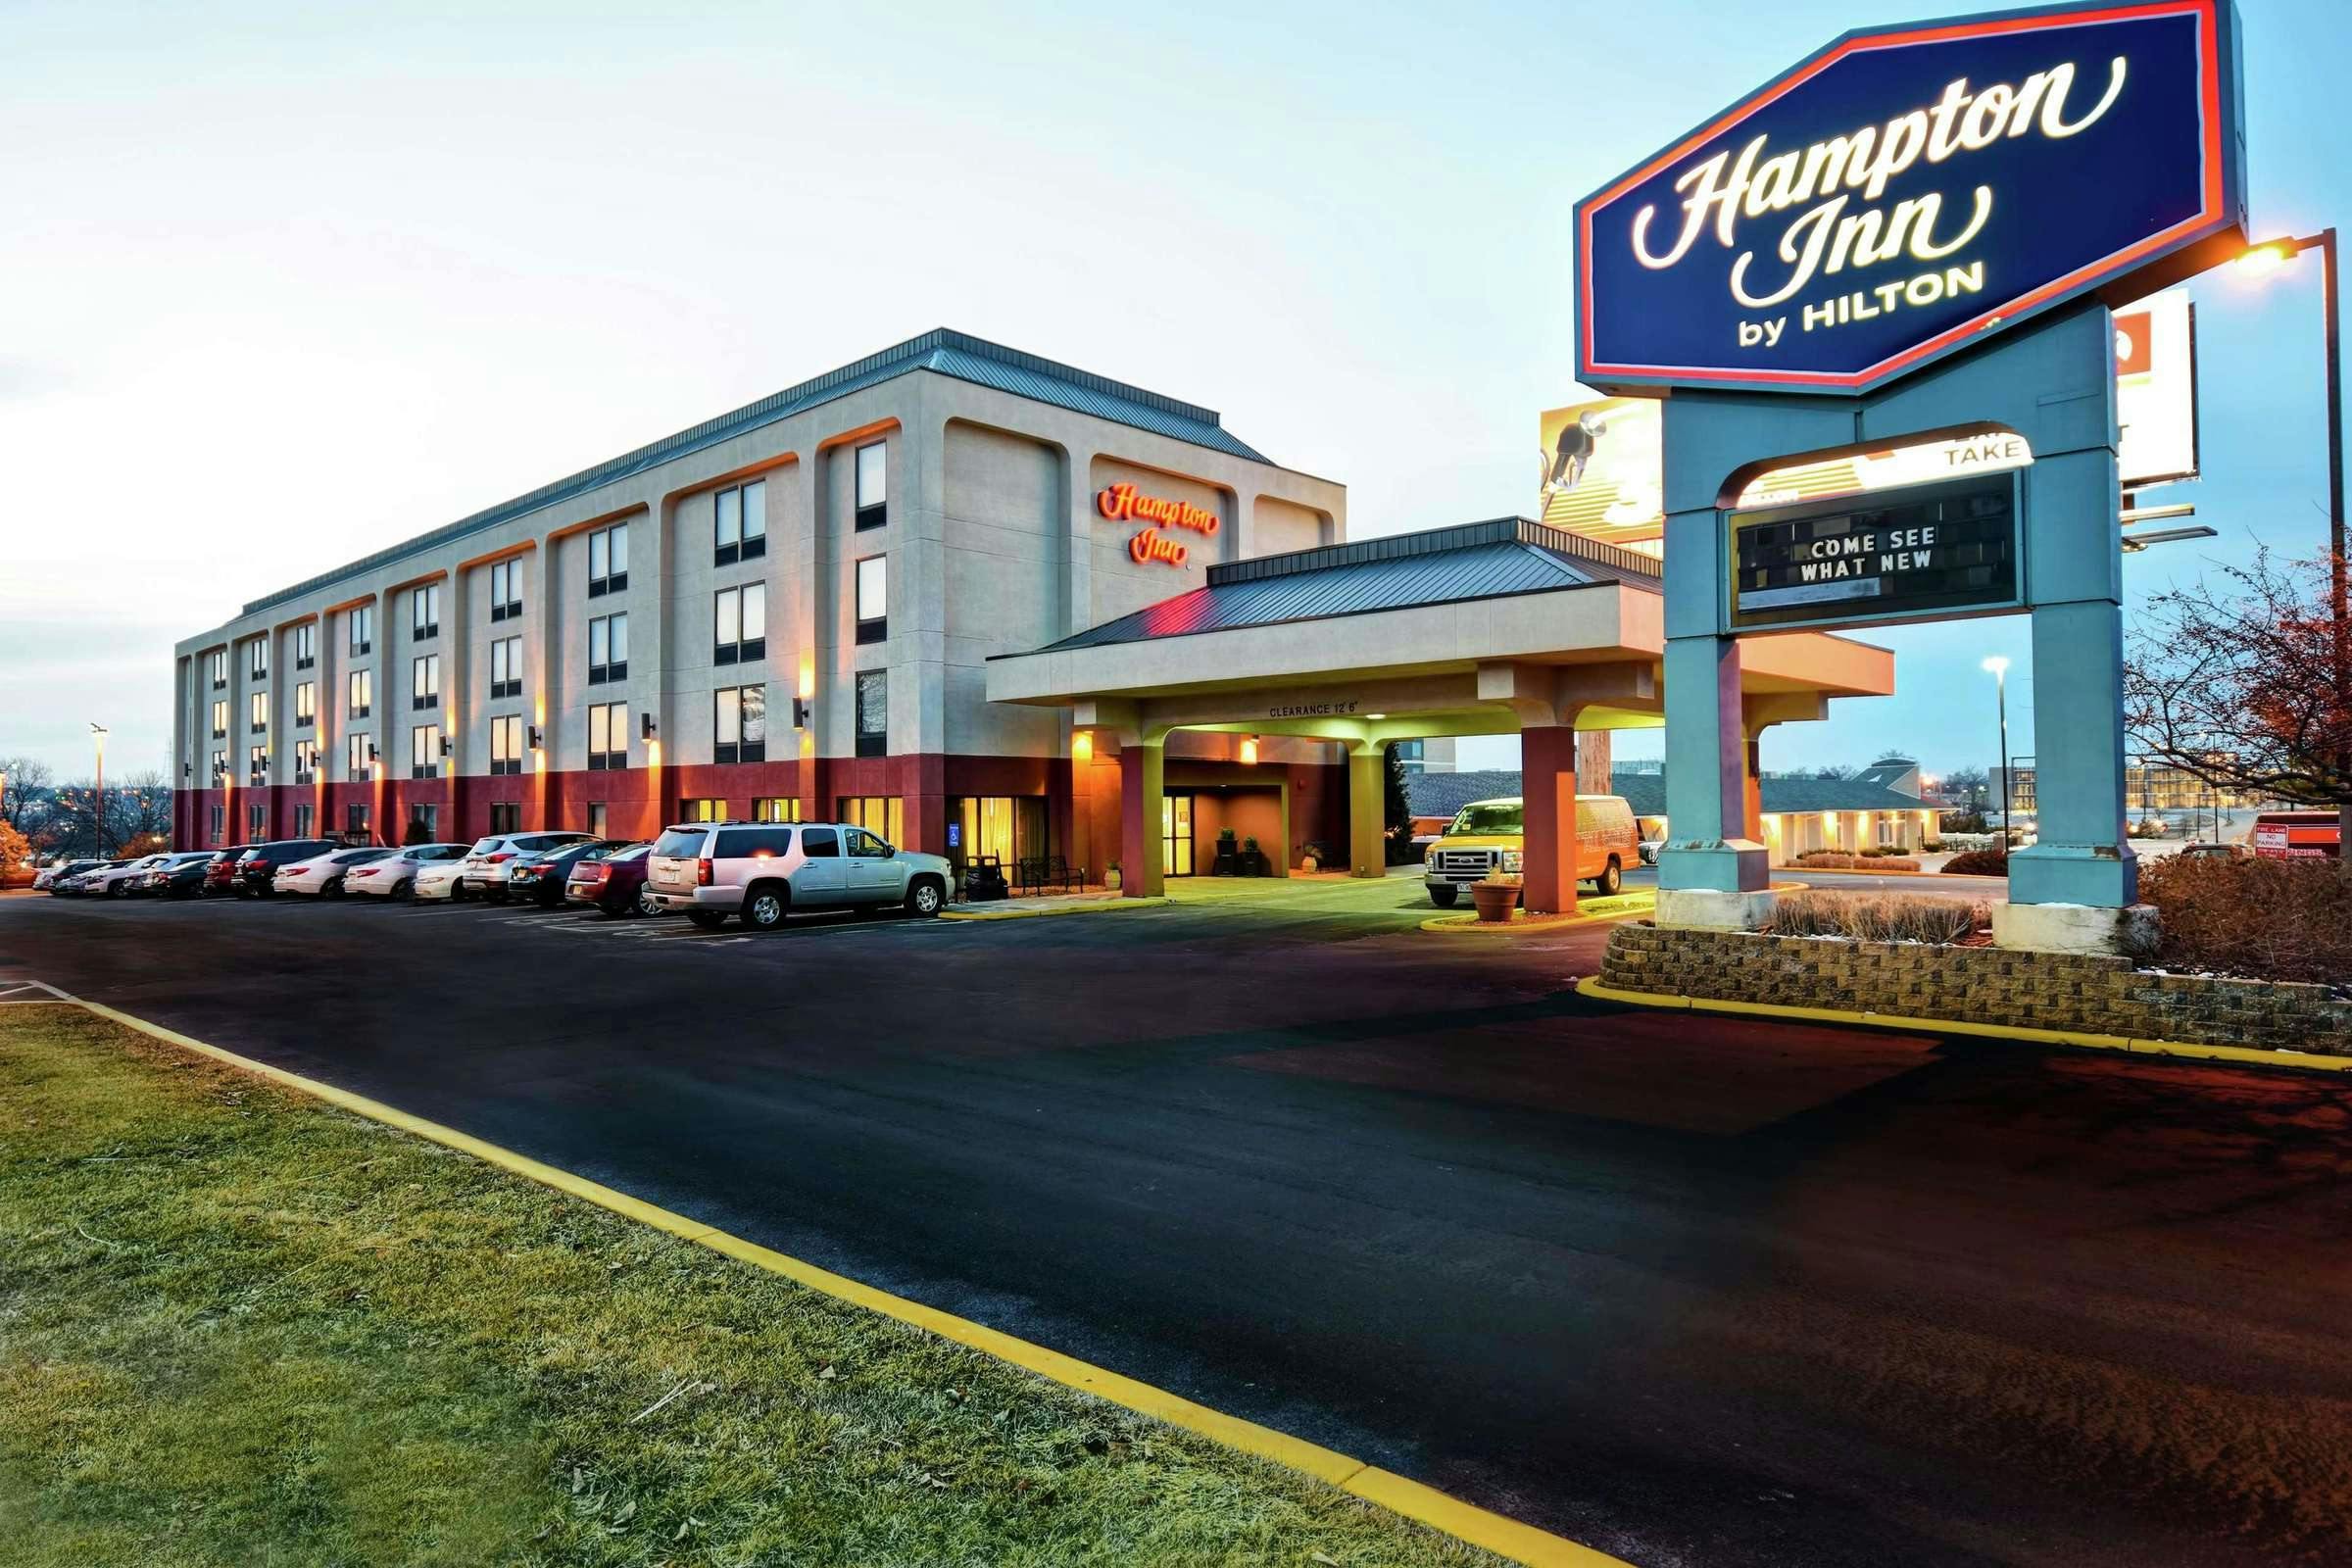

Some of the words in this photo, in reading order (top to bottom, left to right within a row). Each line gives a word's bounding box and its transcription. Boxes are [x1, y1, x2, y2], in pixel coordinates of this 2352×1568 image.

[1632, 56, 2126, 269] Hampton
[1731, 185, 1991, 309] Inn
[1739, 316, 1788, 348] by
[1802, 261, 1984, 332] HILTON
[1944, 439, 2021, 466] TAKE
[1098, 483, 1220, 535] Hampton
[1129, 527, 1188, 564] Inn
[1811, 533, 1876, 559] COME
[1889, 526, 1935, 549] SEE
[1801, 558, 1866, 581] WHAT
[1881, 550, 1932, 572] NEW
[1269, 705, 1330, 717] CLEARANCE
